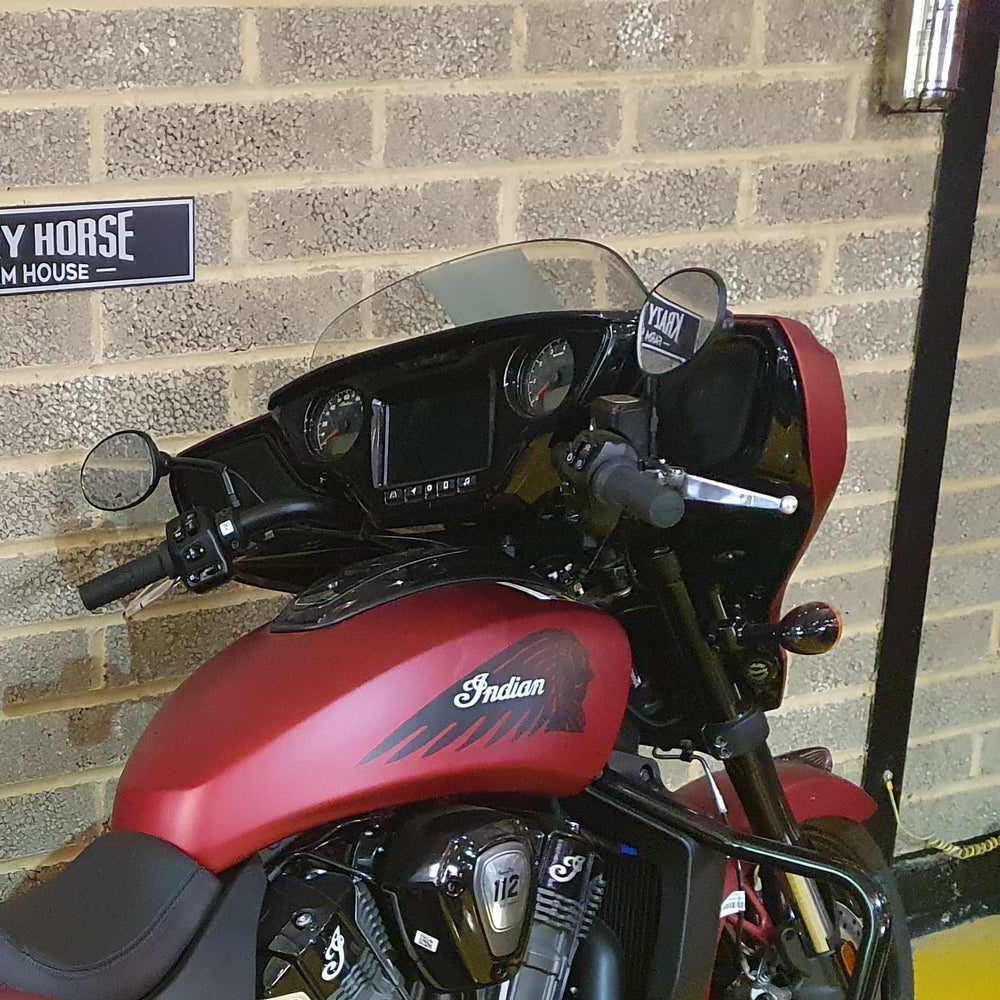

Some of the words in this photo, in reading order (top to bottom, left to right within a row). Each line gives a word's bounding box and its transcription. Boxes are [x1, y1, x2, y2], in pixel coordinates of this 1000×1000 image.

[34, 209, 135, 261] HORSE
[22, 262, 89, 283] HOUSE
[453, 673, 545, 708] Indian
[494, 874, 519, 902] 112
